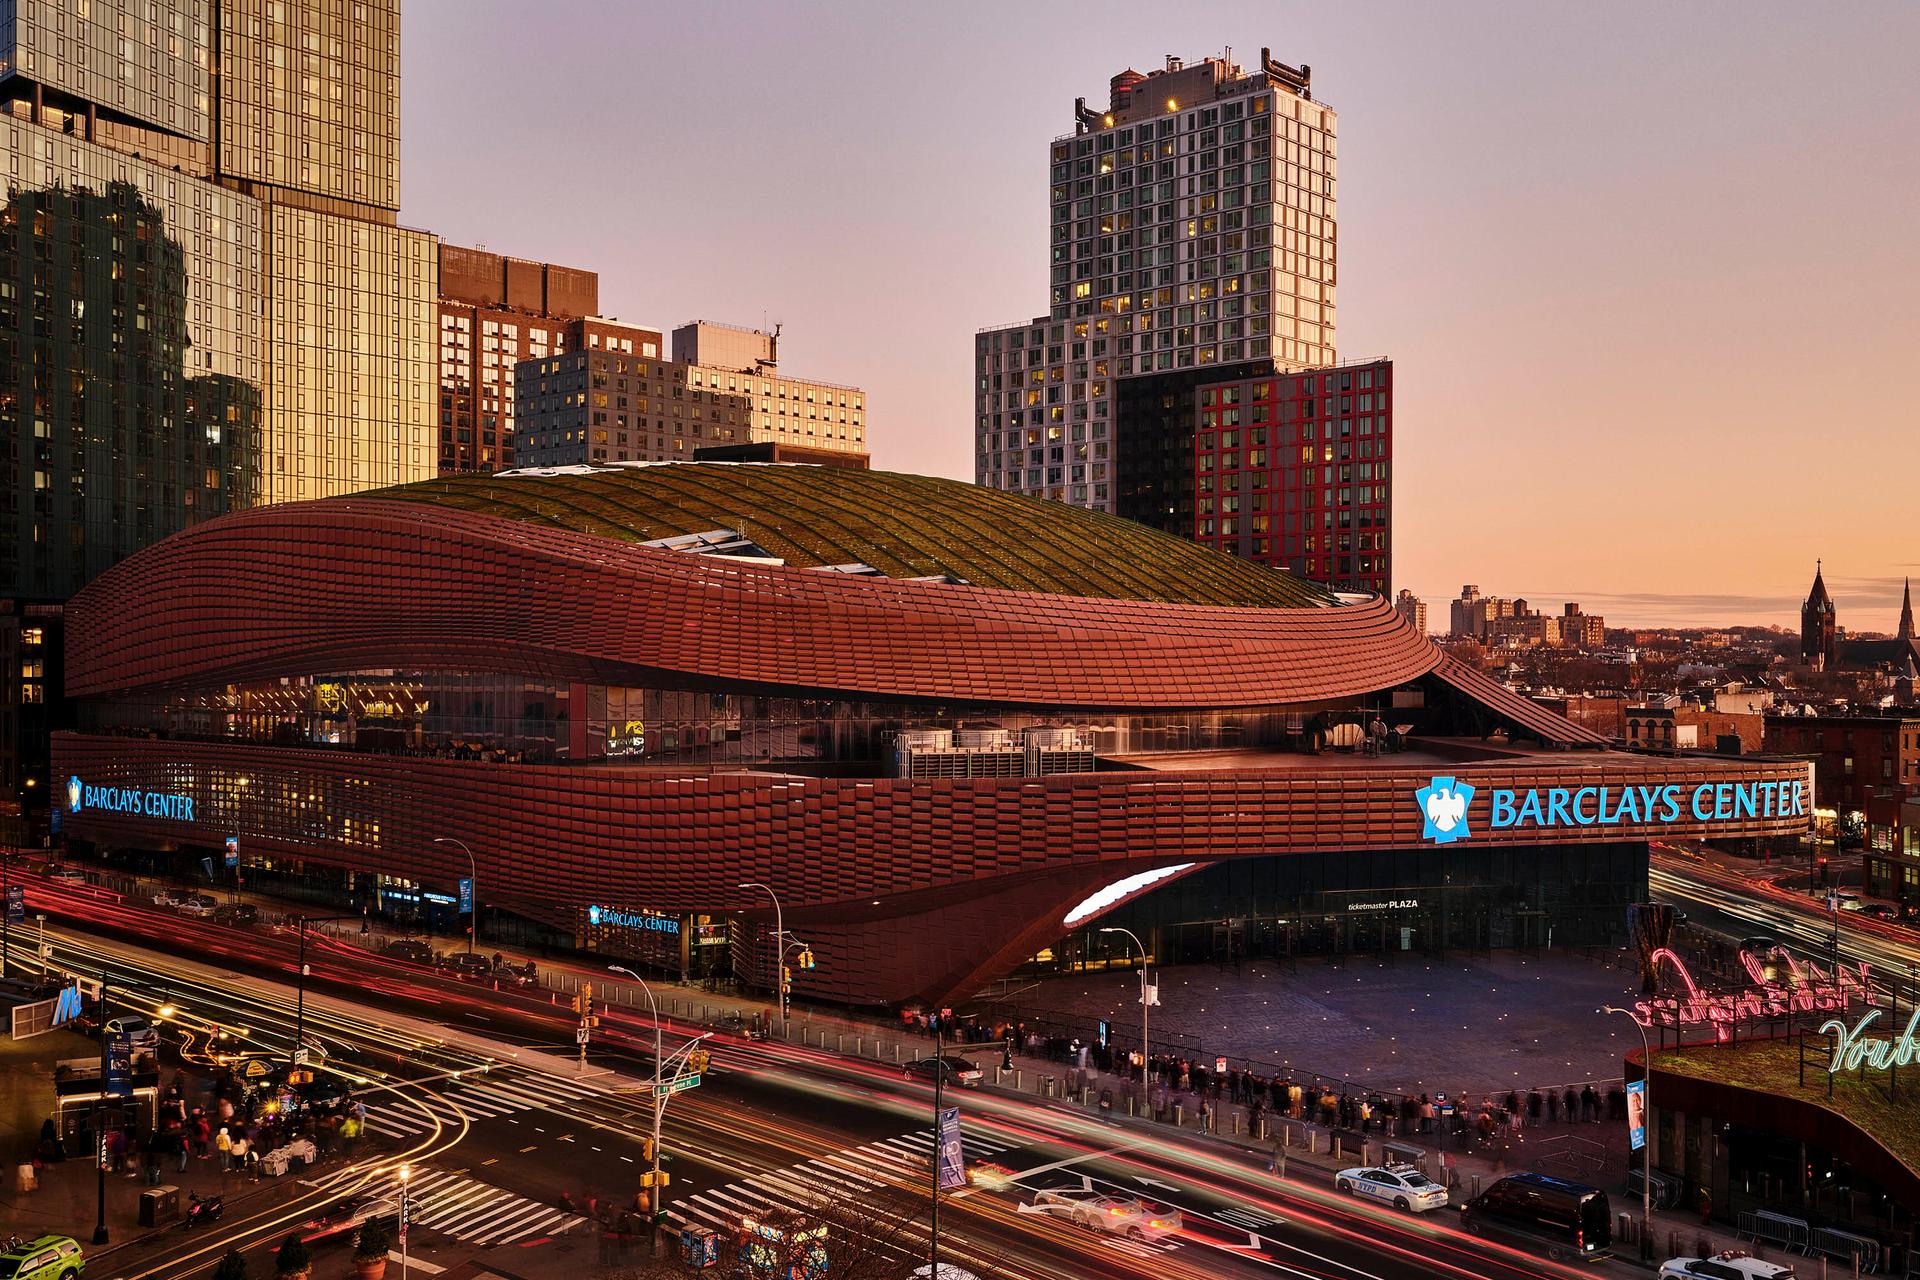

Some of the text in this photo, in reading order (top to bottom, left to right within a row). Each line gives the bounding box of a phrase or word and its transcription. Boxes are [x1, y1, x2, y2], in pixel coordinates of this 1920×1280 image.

[85, 785, 194, 821] BARCLAYS CENTER
[1492, 781, 1803, 827] BARCLAYS CENTER
[1348, 900, 1418, 911] ticketmaster PLAZA
[602, 910, 679, 934] BARCLAYS CENTER
[1819, 1007, 1920, 1073] You b
[1358, 1182, 1377, 1193] NYPD
